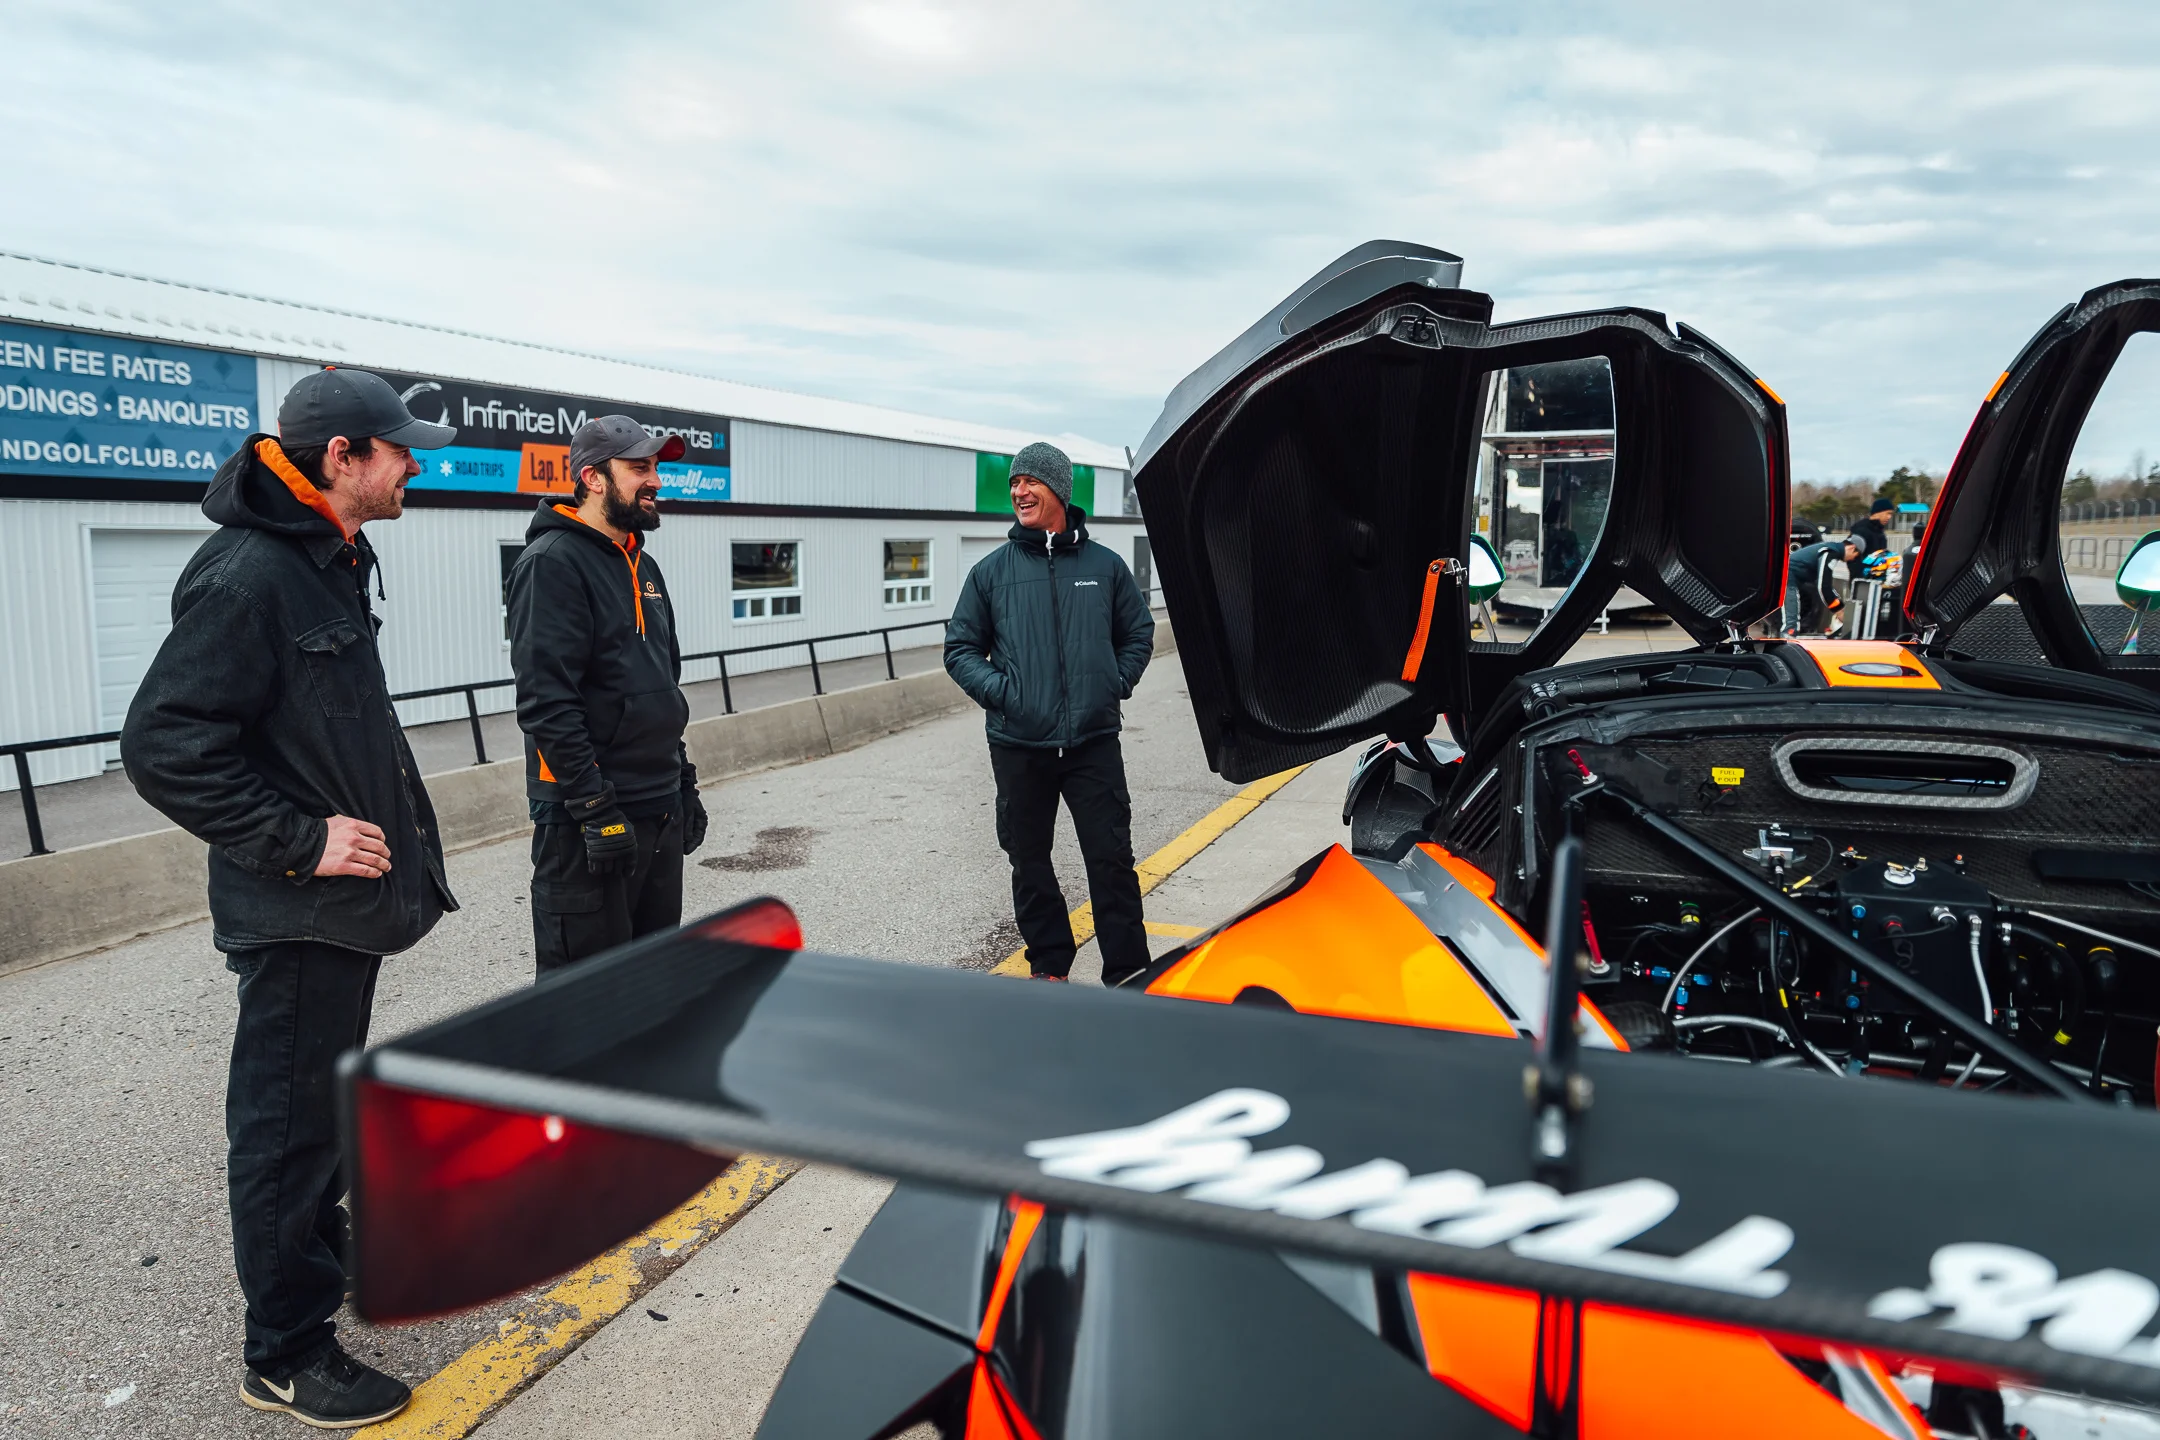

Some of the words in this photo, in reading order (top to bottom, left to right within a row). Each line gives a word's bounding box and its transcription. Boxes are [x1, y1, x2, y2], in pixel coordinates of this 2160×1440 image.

[0, 340, 46, 371] EN
[53, 346, 106, 376] FEE
[112, 354, 192, 385] RATES
[118, 395, 250, 430] BANQUETS
[455, 460, 480, 476] ROAD
[480, 462, 504, 477] TRIPS
[530, 452, 558, 488] Lap.
[699, 476, 726, 491] AUTO
